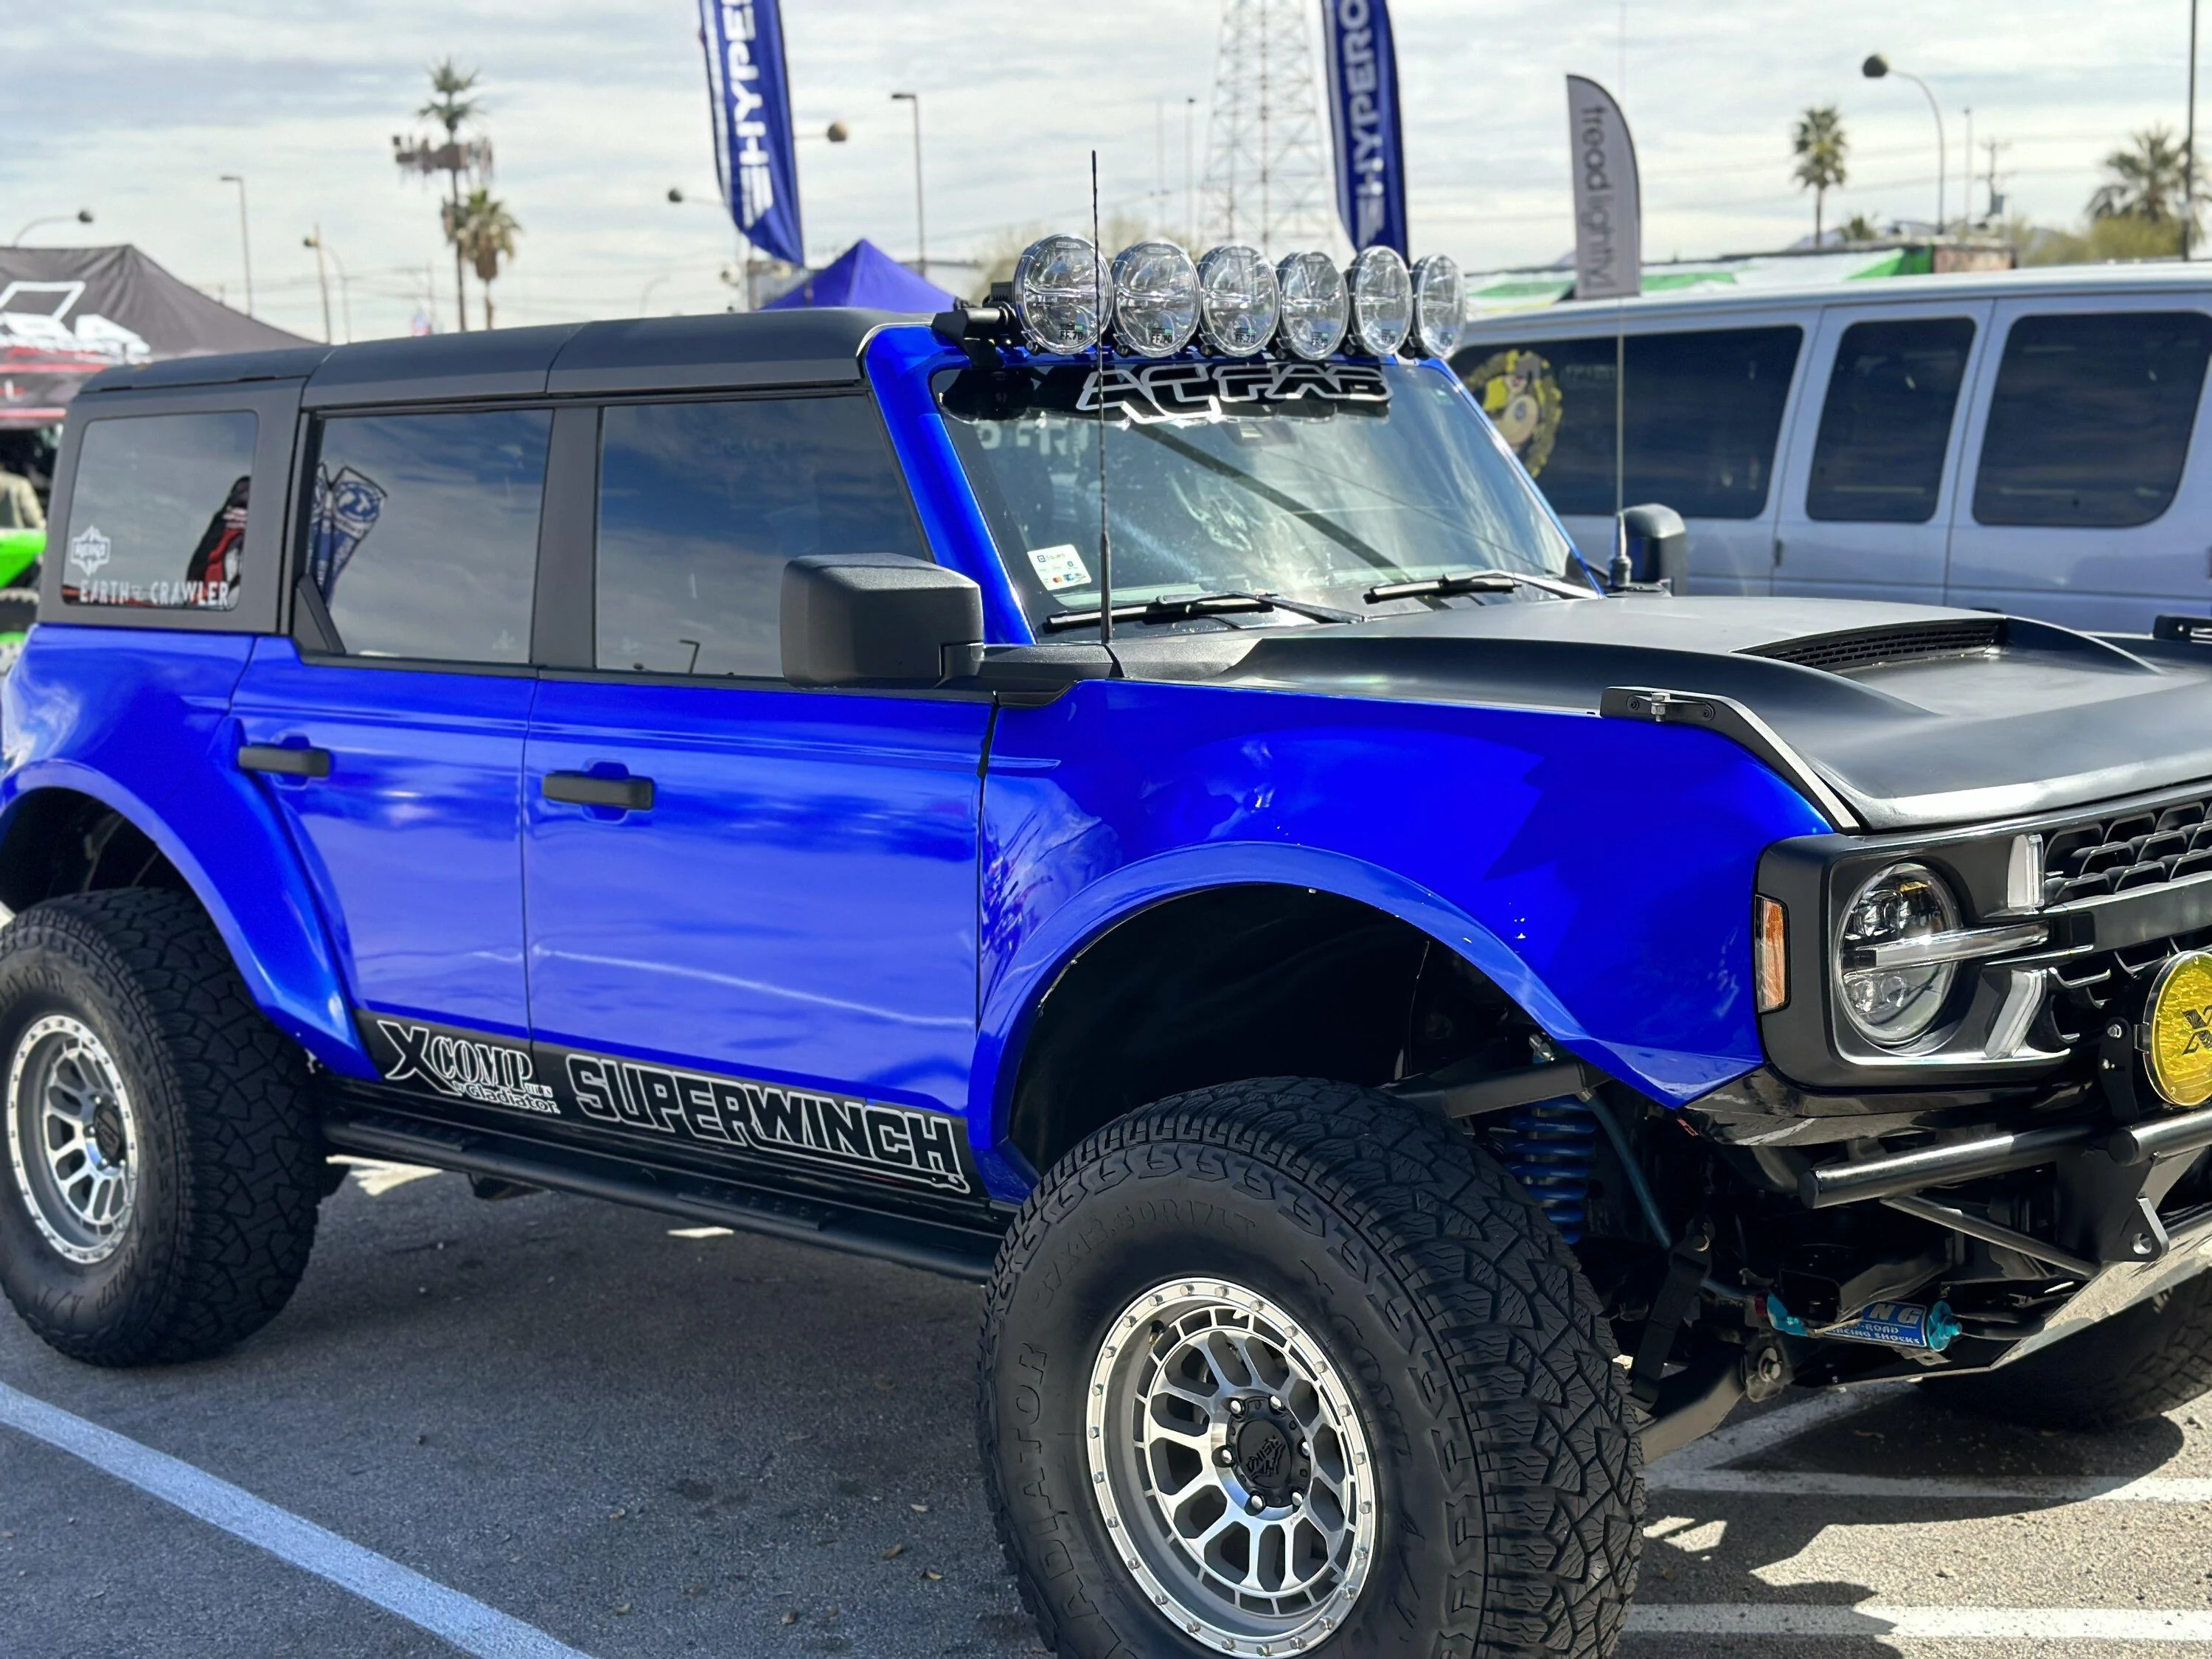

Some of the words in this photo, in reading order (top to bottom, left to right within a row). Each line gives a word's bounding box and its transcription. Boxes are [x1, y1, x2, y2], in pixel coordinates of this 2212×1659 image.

[150, 580, 230, 606] CRAWLER
[465, 1082, 560, 1114] Gladiator
[566, 1054, 967, 1184] SUPERWINCH
[1875, 1332, 1920, 1344] SHOCKS
